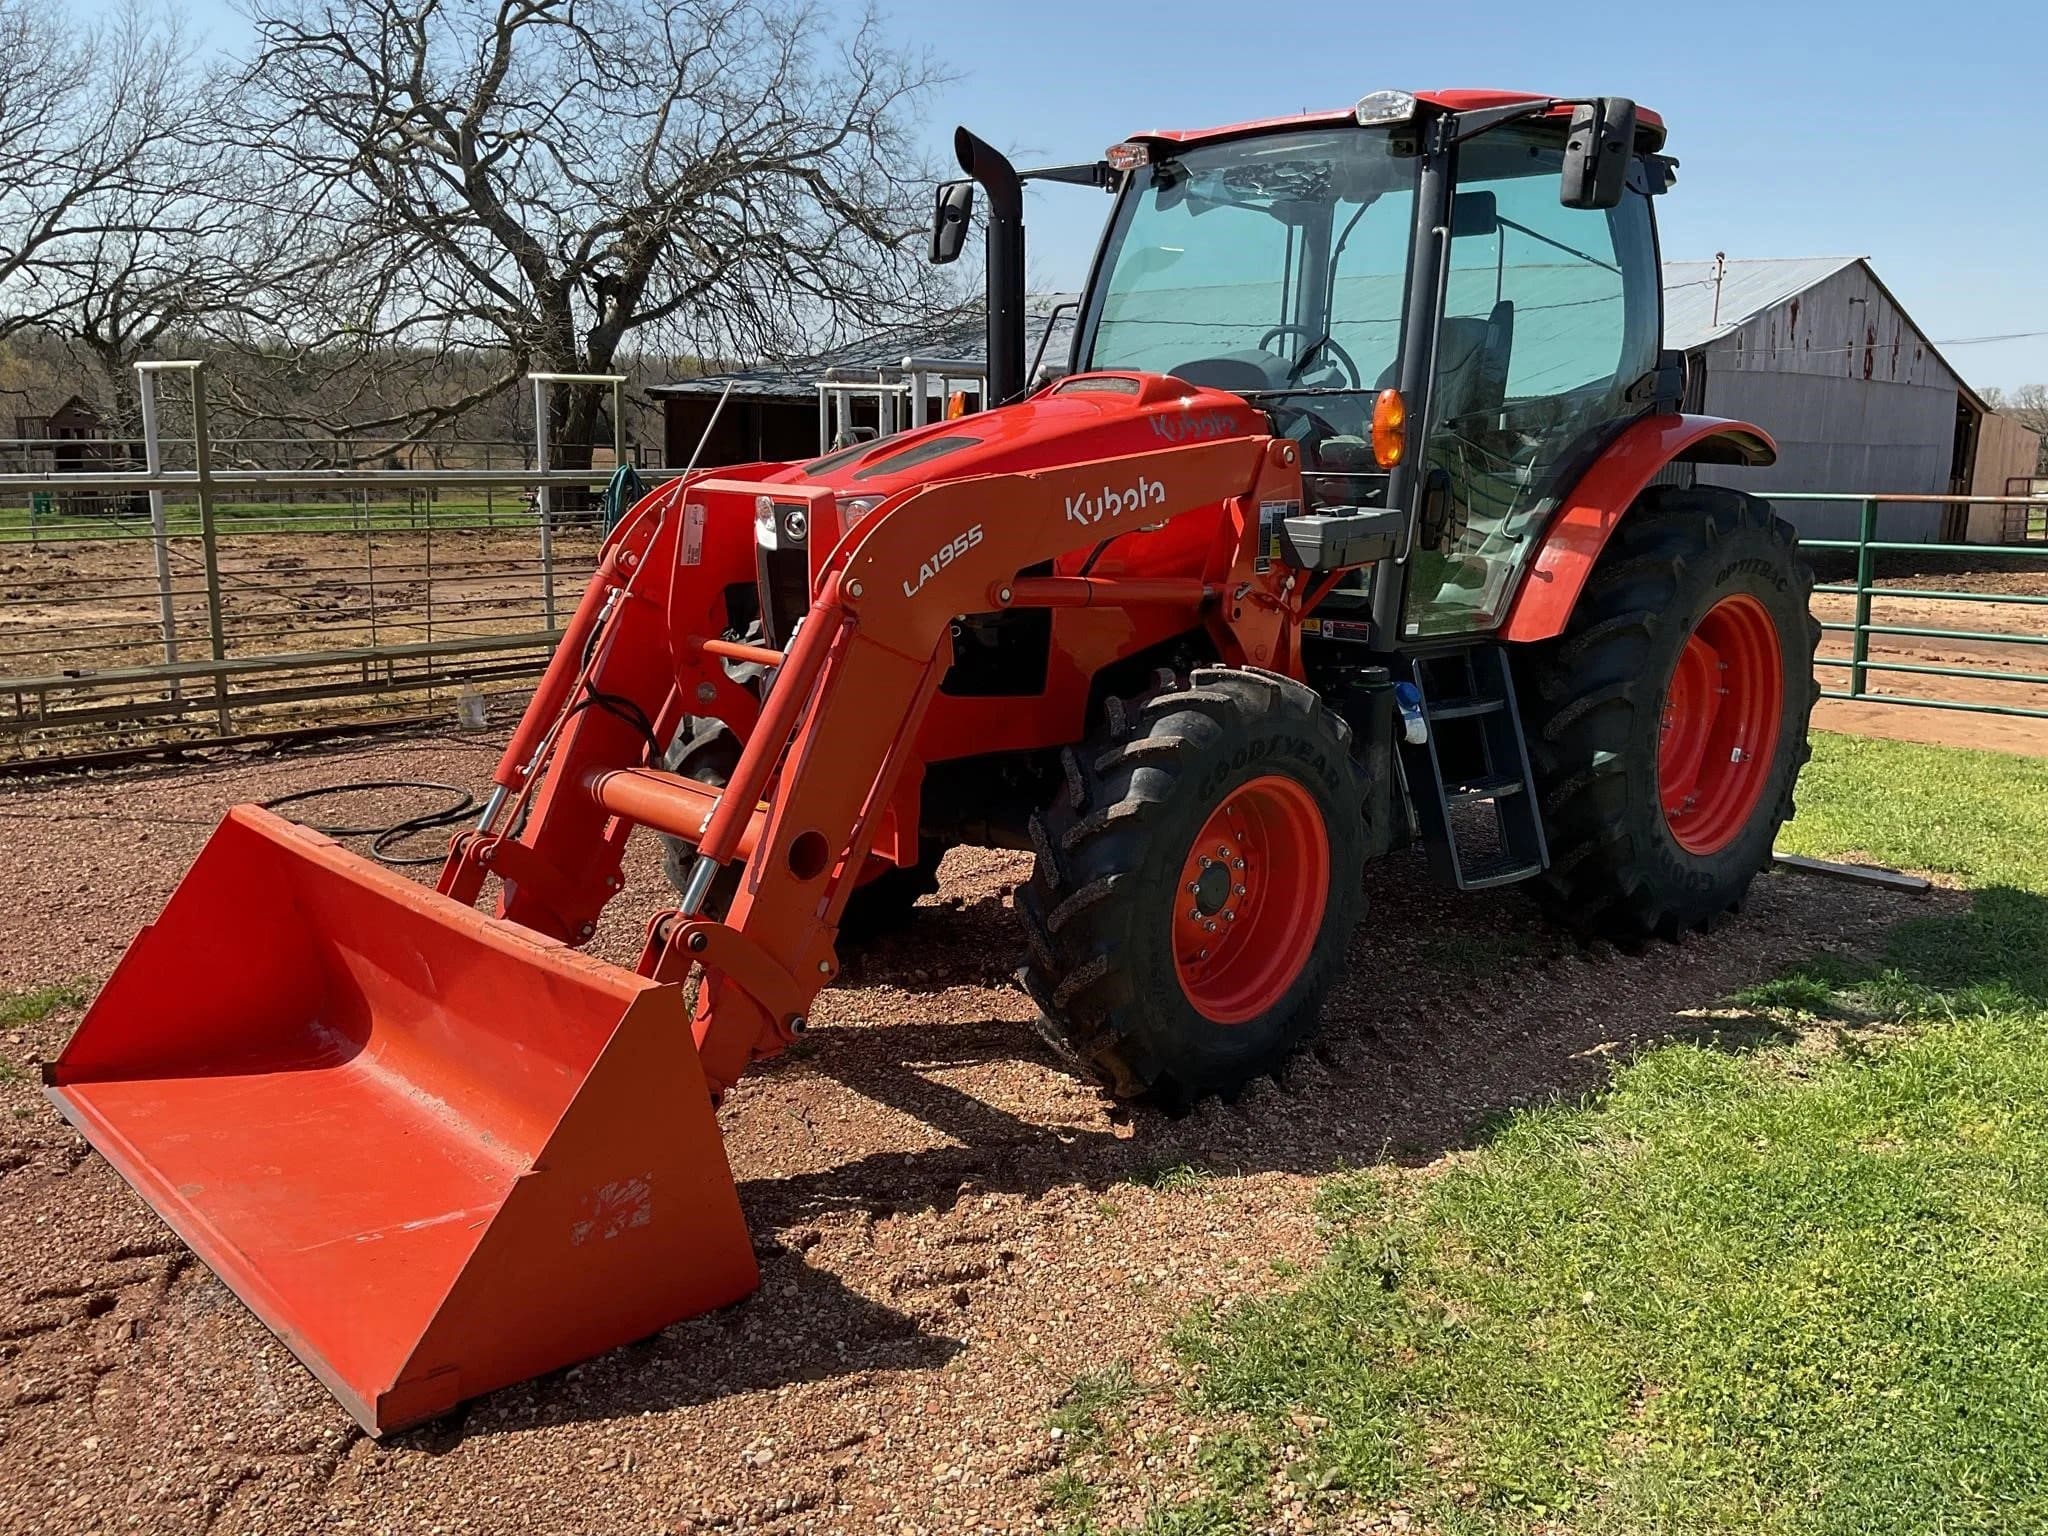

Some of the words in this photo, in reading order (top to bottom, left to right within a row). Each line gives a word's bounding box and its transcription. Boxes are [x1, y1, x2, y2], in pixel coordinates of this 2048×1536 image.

[1149, 409, 1236, 441] Kubota
[1065, 476, 1165, 525] Kubota
[903, 523, 983, 597] LA1955
